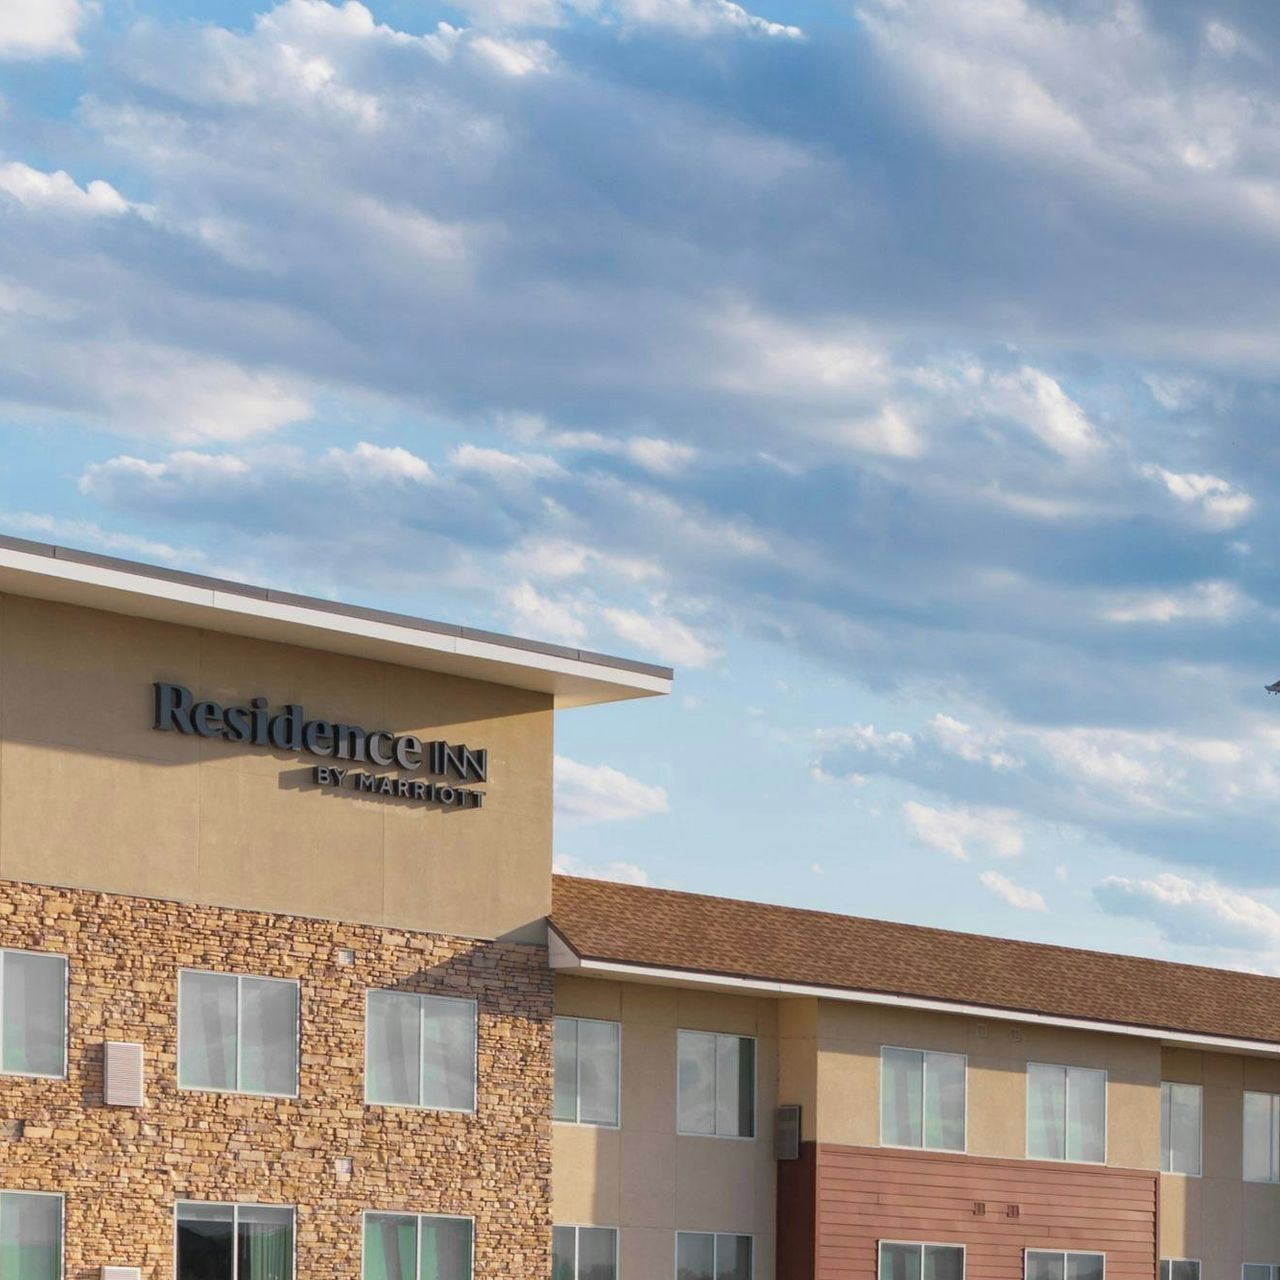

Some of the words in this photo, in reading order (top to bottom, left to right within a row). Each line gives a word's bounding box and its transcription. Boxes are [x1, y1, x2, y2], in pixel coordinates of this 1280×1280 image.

[153, 682, 422, 770] Residence
[431, 741, 487, 783] INN
[314, 767, 348, 787] BY
[355, 773, 486, 808] MARRIOTT
